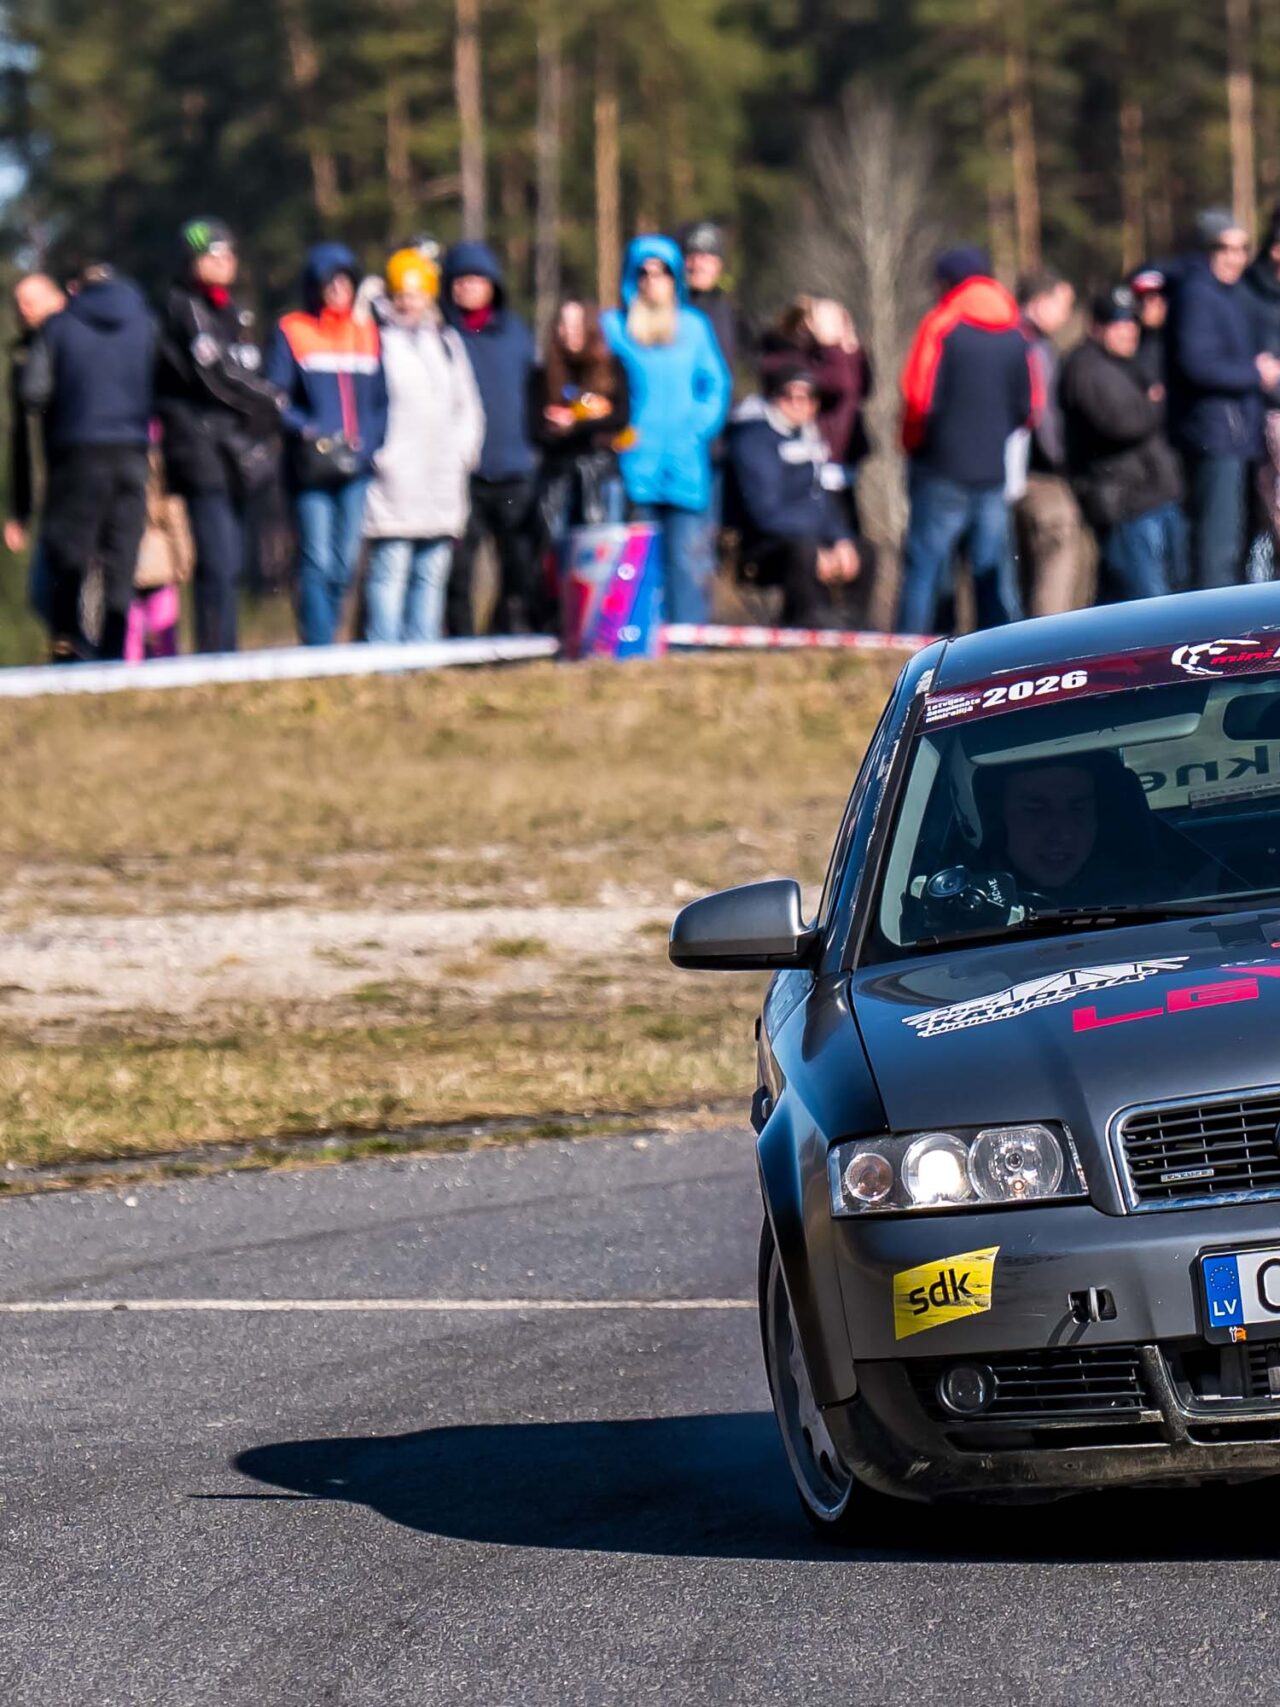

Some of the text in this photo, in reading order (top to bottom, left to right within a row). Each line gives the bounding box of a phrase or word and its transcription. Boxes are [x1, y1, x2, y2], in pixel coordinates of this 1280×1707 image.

[982, 670, 1088, 709] 2026
[909, 1268, 975, 1316] sdk
[1213, 1299, 1238, 1317] LV
